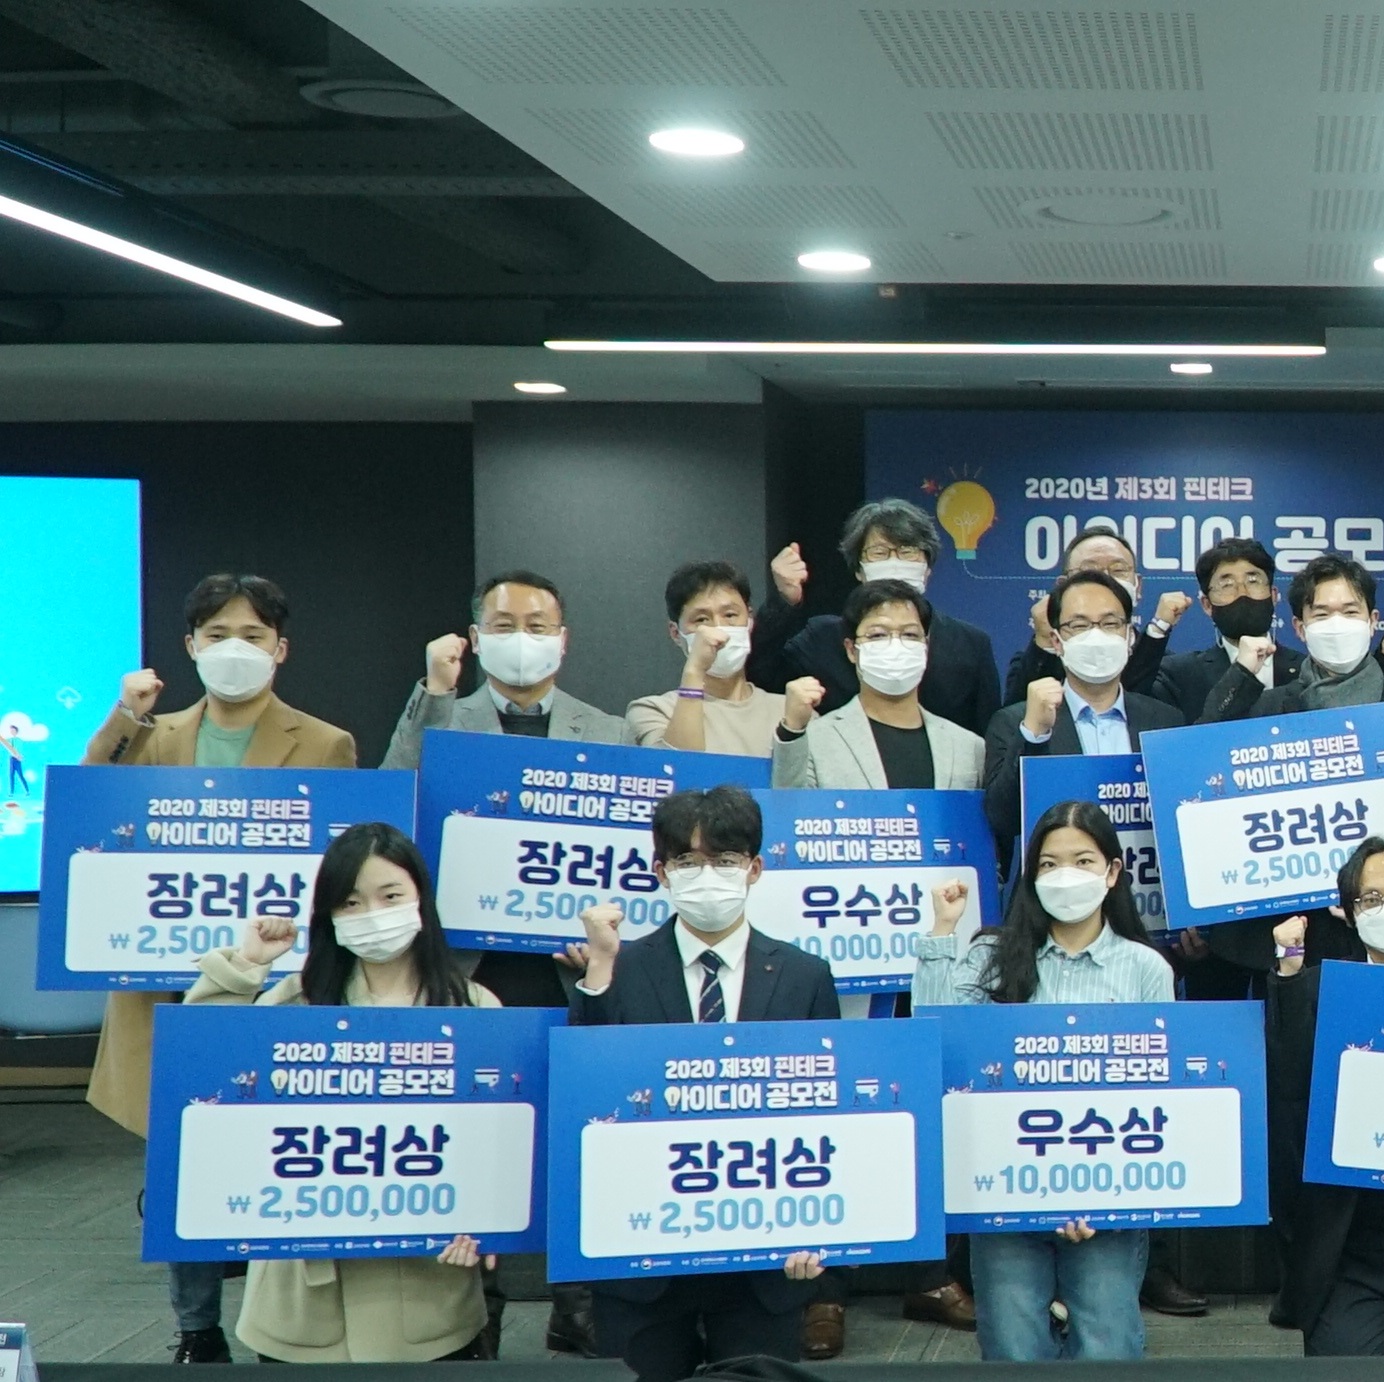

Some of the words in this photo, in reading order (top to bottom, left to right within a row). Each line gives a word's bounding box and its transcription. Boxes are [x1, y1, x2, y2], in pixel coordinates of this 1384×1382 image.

[1025, 476, 1109, 500] 2020년
[1115, 476, 1176, 501] 제3회
[1184, 477, 1253, 501] 핀테크
[1230, 746, 1268, 764] 2020
[1271, 740, 1309, 760] 제3회
[1312, 735, 1359, 756] 핀테크
[522, 768, 567, 787] 2020
[570, 772, 616, 793] 제3회
[620, 776, 674, 798] 핀테크
[1233, 763, 1307, 791] 아이디어
[1309, 755, 1364, 782] 공모전
[1098, 783, 1131, 799] 2020
[148, 799, 194, 817] 2020
[199, 798, 247, 818] 제3회
[251, 799, 310, 819] 핀테크
[519, 791, 605, 816] 아이디어
[609, 798, 657, 822] 공모
[146, 822, 236, 847] 아이디어
[242, 823, 311, 847] 공모전
[795, 819, 831, 835] 2020
[834, 818, 872, 835] 제3회
[874, 818, 919, 836] 핀테크
[1243, 799, 1368, 853] 장려상
[795, 840, 867, 862] 아이디어
[870, 839, 922, 861] 공모전
[147, 872, 305, 918] 장려상
[802, 883, 923, 928] 우수상
[273, 1043, 326, 1063] 2020
[330, 1042, 385, 1064] 제3회
[389, 1042, 454, 1065] 핀테크
[1015, 1036, 1059, 1054] 2020
[1062, 1035, 1109, 1055] 제3회
[1112, 1034, 1167, 1055] 핀테크
[665, 1059, 715, 1079] 2020
[719, 1056, 770, 1078] 제3회
[775, 1055, 836, 1078] 핀테크
[1014, 1059, 1101, 1085] 아이디어
[1104, 1057, 1170, 1083] 공모전
[270, 1069, 373, 1096] 아이디어
[378, 1069, 455, 1096] 공모전
[664, 1083, 762, 1112] 아이디어
[766, 1081, 837, 1108] 공모전
[1017, 1106, 1168, 1156] 우수상
[272, 1124, 450, 1178] 장려상
[669, 1135, 836, 1193] 장려상
